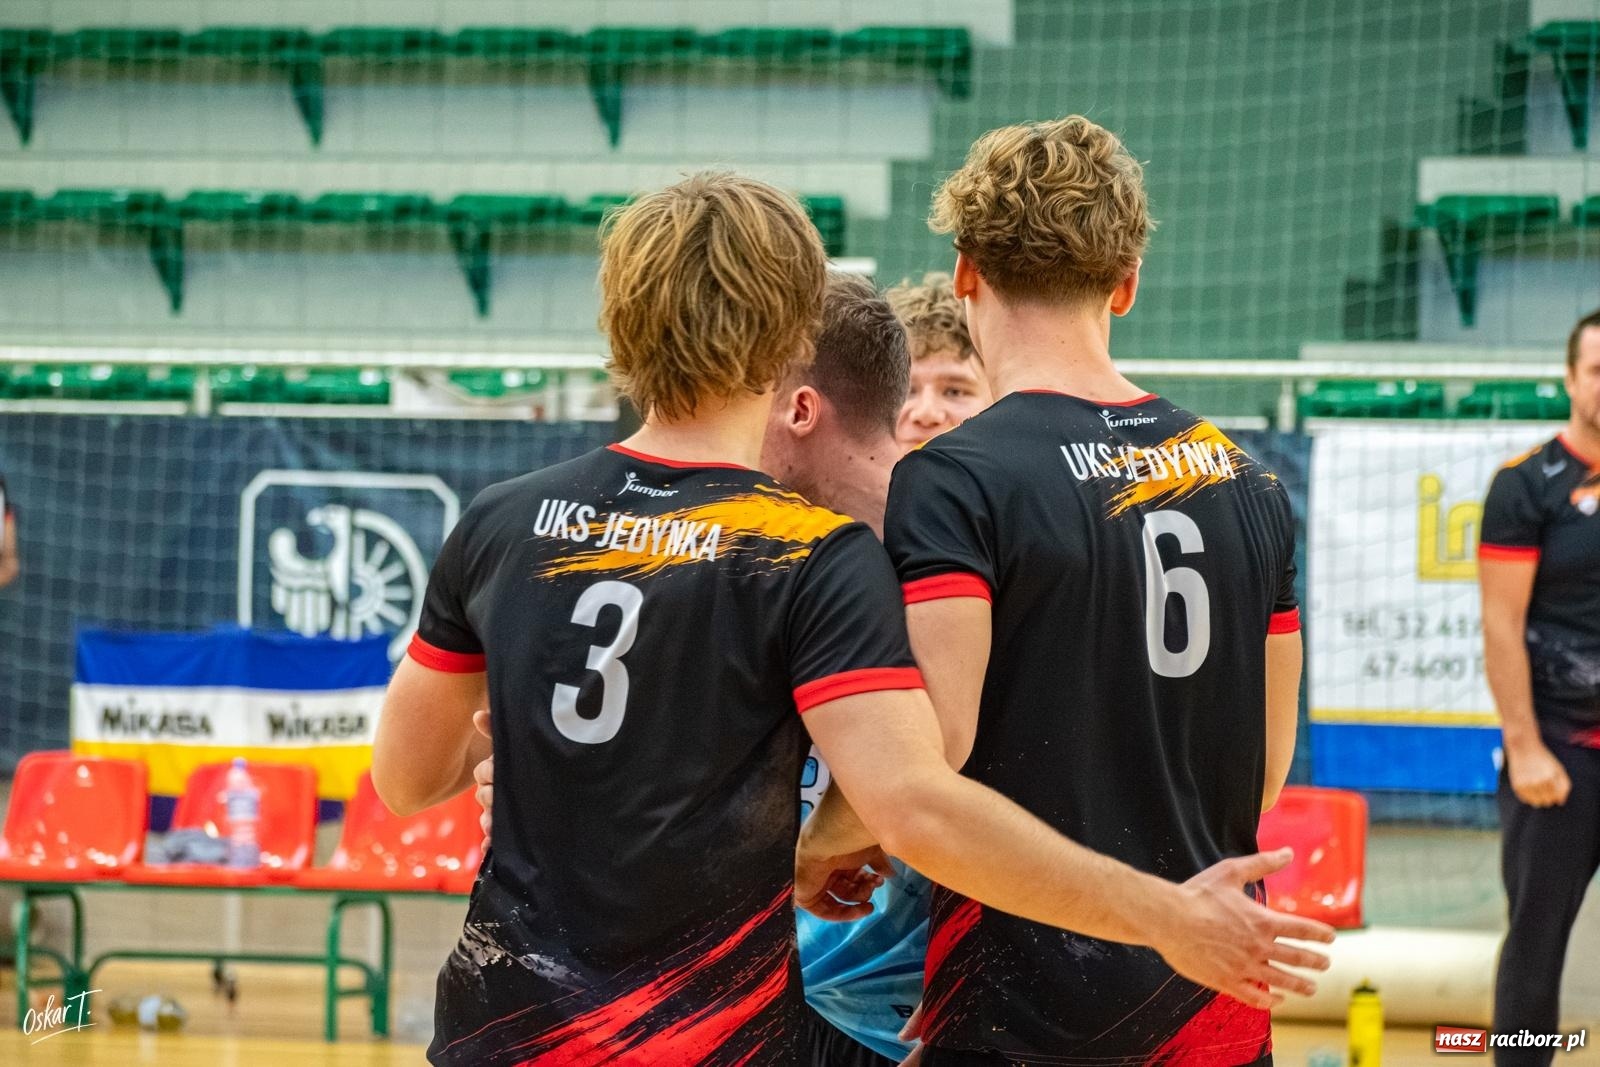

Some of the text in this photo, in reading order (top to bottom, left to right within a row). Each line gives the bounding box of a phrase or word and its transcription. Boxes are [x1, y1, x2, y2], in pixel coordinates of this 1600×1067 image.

[1060, 441, 1237, 483] UKS JEDYNKA
[532, 498, 722, 562] UKS JEDYNKA
[1142, 509, 1211, 678] 6
[551, 580, 644, 744] 3
